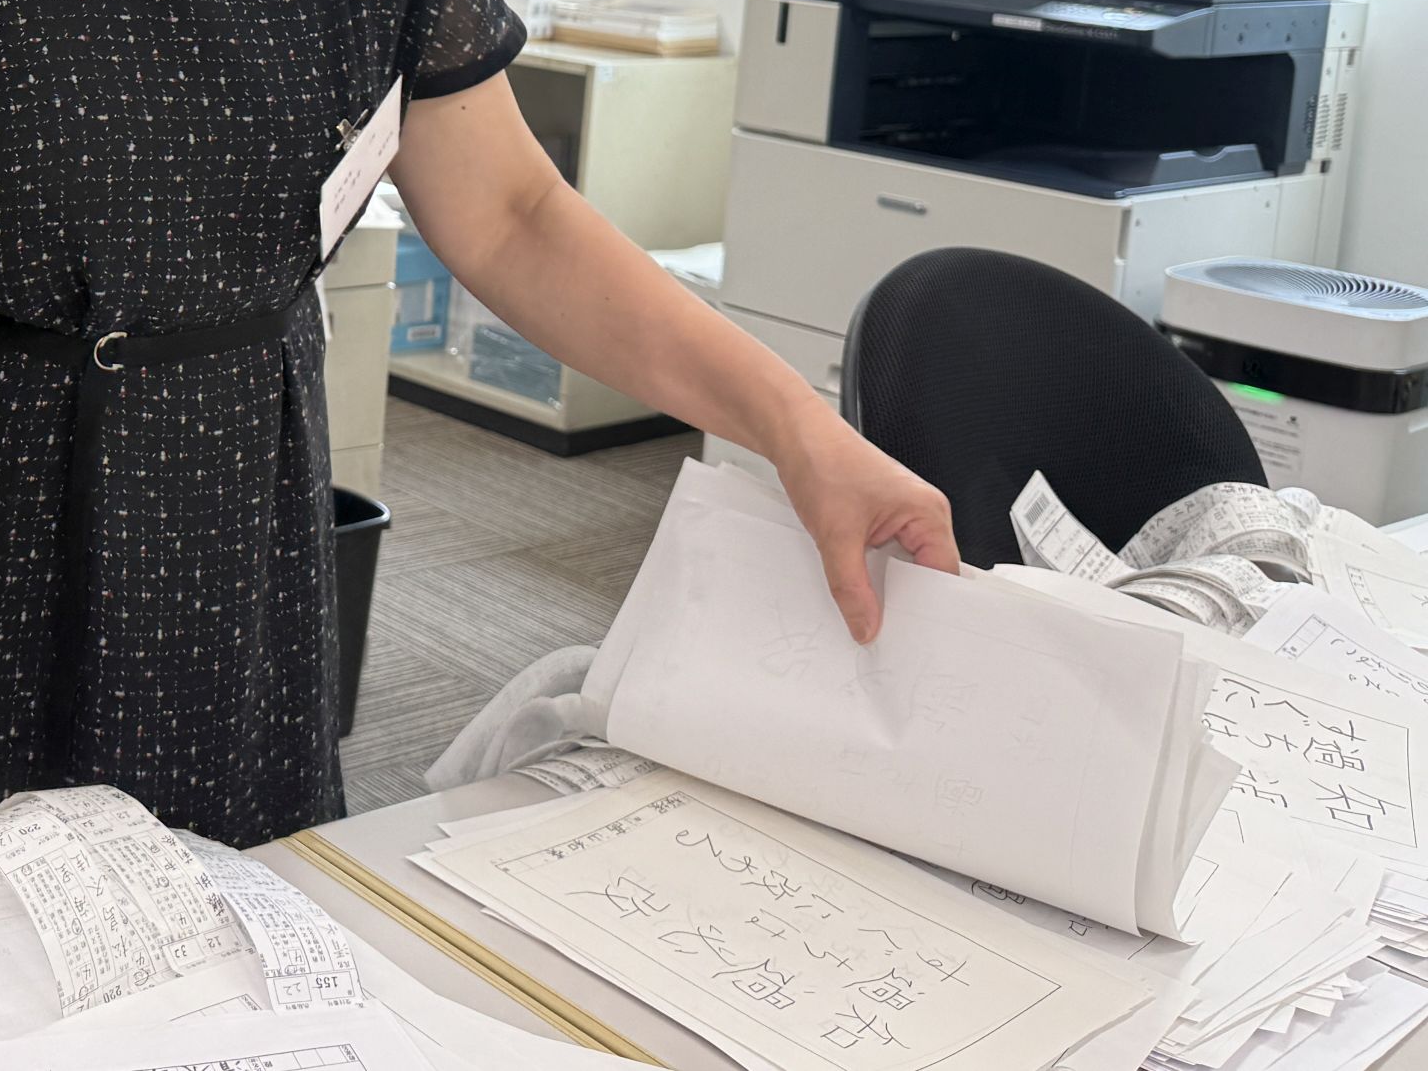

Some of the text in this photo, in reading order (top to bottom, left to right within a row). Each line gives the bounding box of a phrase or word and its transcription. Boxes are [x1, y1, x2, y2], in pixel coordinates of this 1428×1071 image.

[18, 823, 41, 836] 220
[675, 828, 971, 987] すぐに改める
[178, 913, 187, 925] 4
[206, 935, 222, 949] 12
[566, 875, 912, 1050] 知過必改
[744, 906, 926, 1011] 過ちは
[283, 982, 301, 996] 22
[315, 976, 338, 989] 155
[102, 985, 122, 1004] 220
